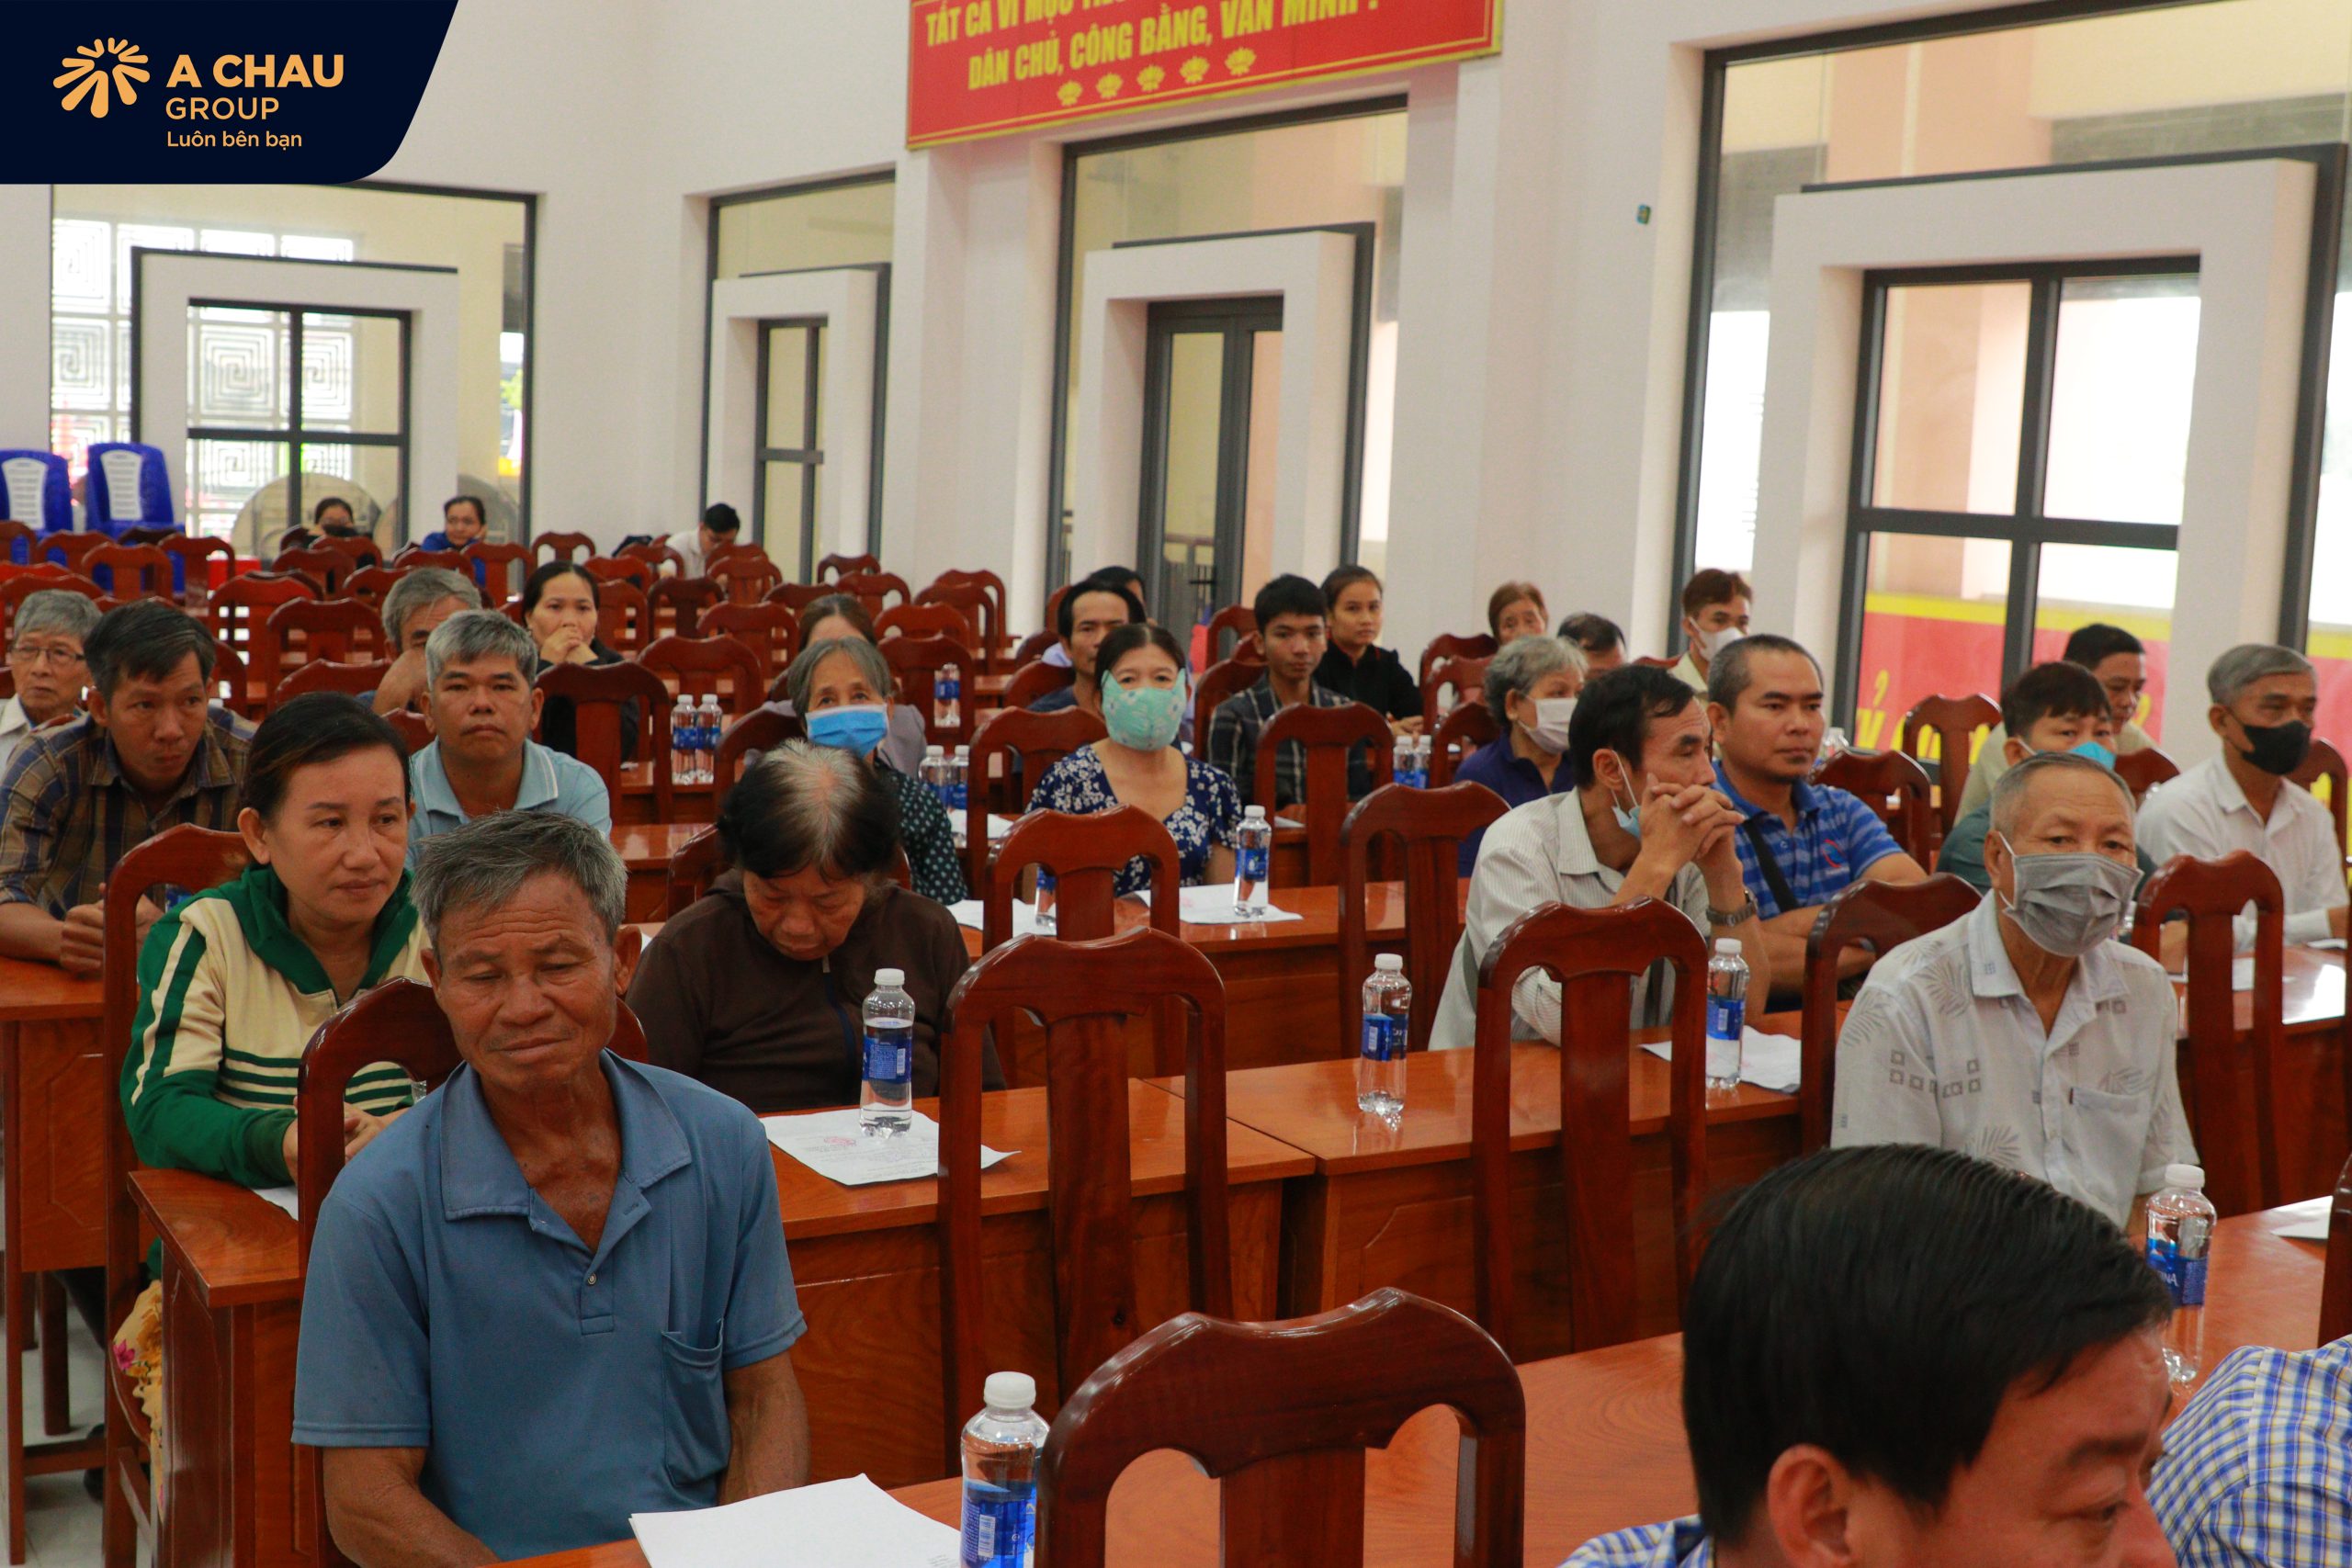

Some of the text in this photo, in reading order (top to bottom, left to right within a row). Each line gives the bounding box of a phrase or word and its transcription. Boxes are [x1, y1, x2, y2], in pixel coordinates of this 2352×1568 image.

[968, 46, 1010, 90] DÂN
[1014, 29, 1064, 80] CHỦ,
[1069, 22, 1133, 70] CÔNG
[1139, 3, 1213, 56] BẰNG,
